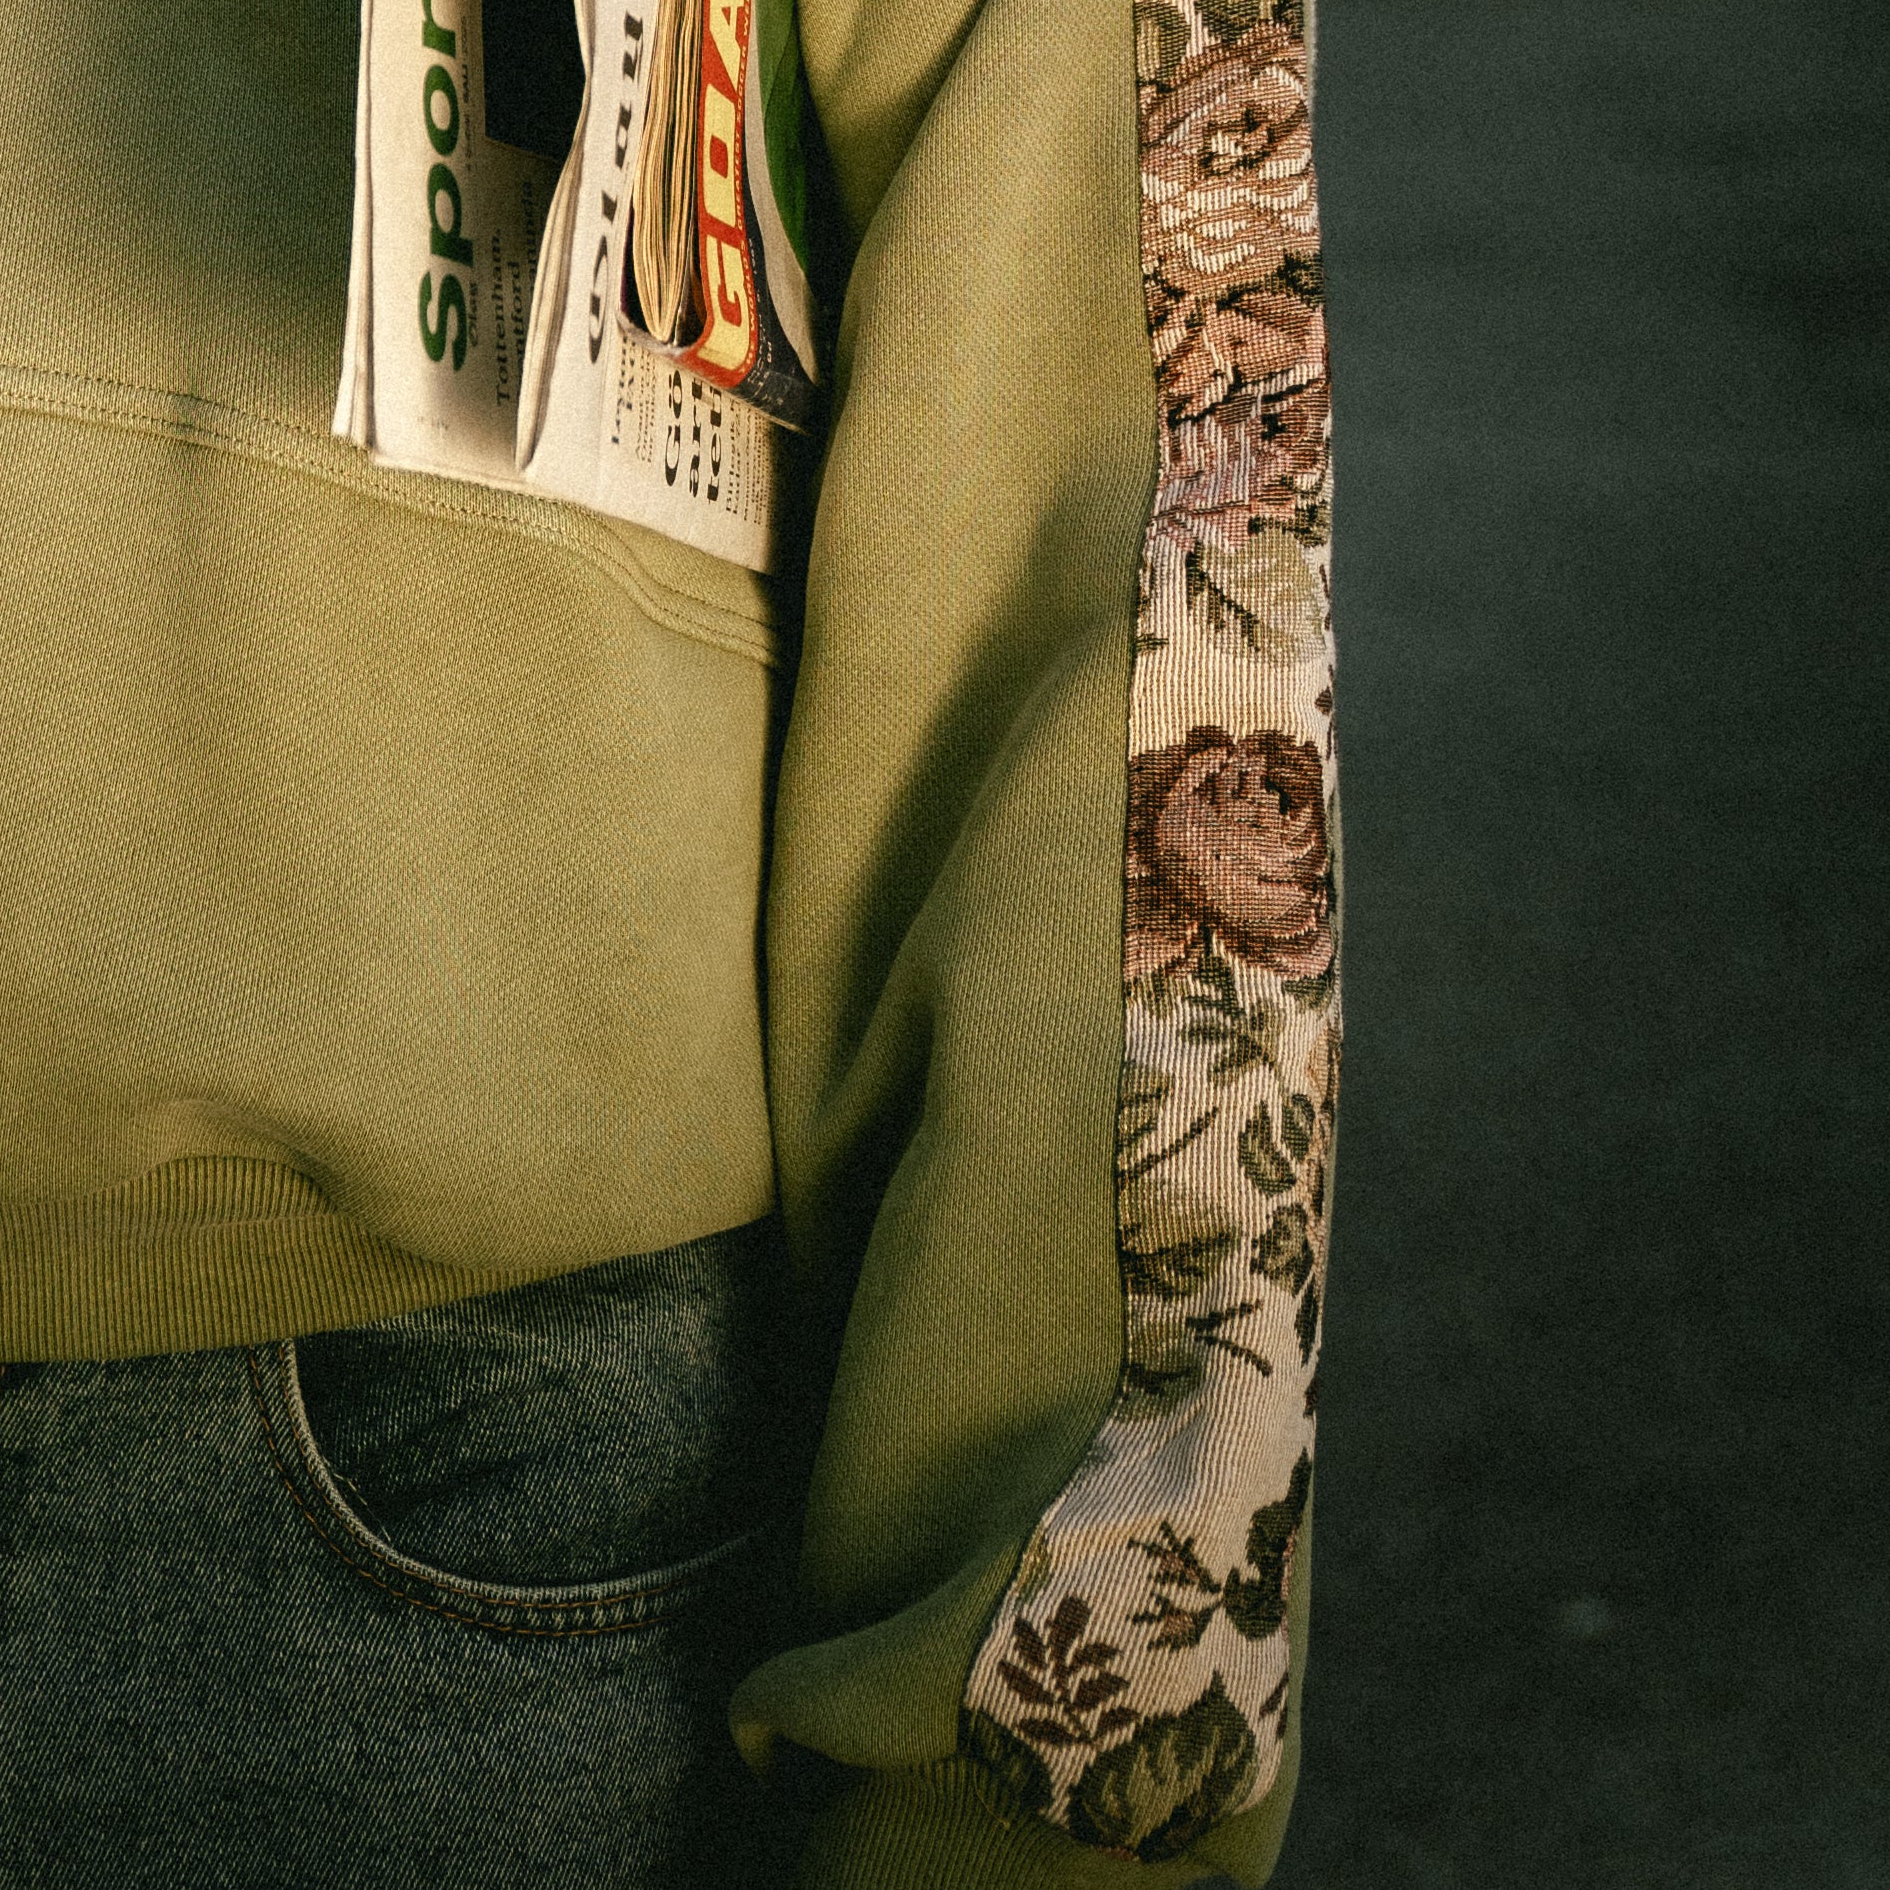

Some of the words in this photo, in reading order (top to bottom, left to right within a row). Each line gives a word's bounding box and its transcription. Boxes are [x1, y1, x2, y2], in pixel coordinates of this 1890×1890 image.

[737, 46, 747, 123] SOCCER
[734, 129, 742, 230] GREATEST
[491, 227, 510, 407] Tottenham,
[741, 239, 755, 331] WORLD'S
[665, 370, 682, 487] Gö
[689, 377, 702, 499] art
